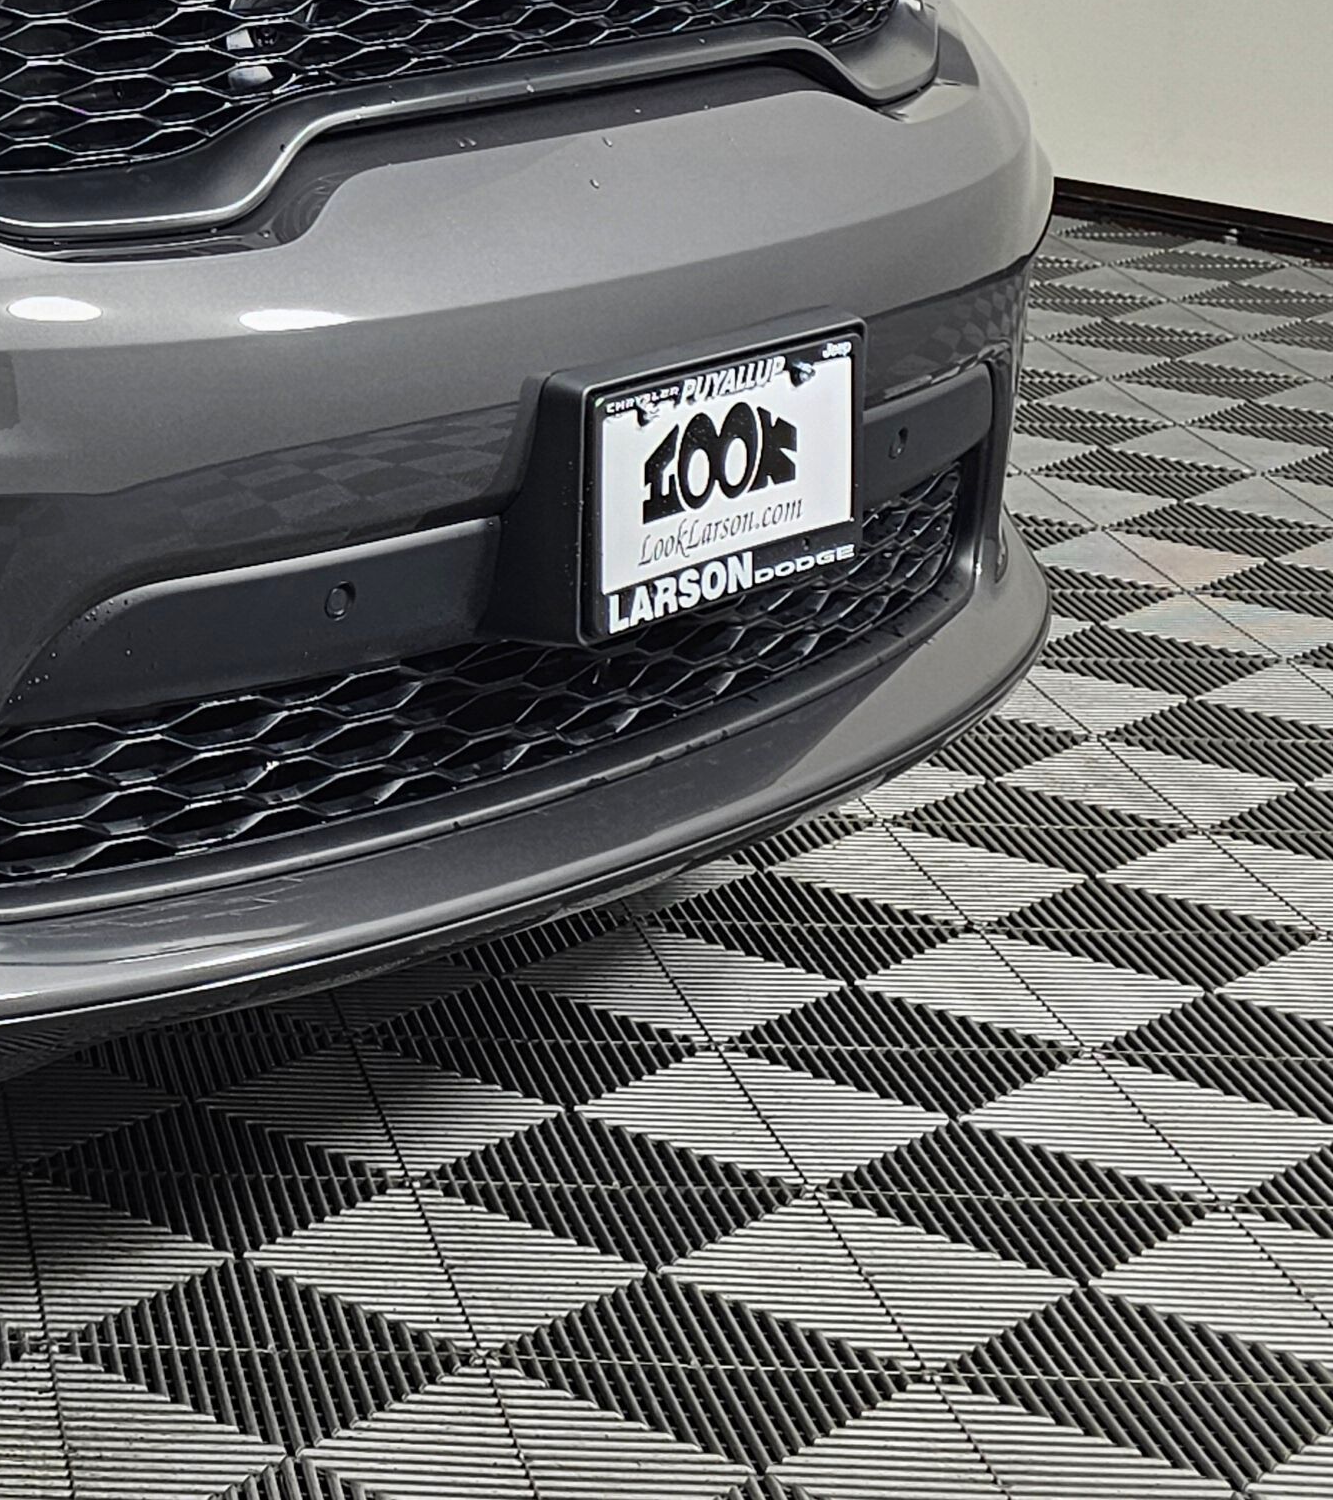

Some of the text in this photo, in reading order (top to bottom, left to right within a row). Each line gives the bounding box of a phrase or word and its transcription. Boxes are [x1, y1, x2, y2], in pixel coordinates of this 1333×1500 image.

[605, 386, 680, 414] CHRYSLER
[682, 356, 786, 403] PUYALLUP
[637, 498, 803, 567] LookLarson.com
[608, 543, 855, 635] LARSON DODGE
